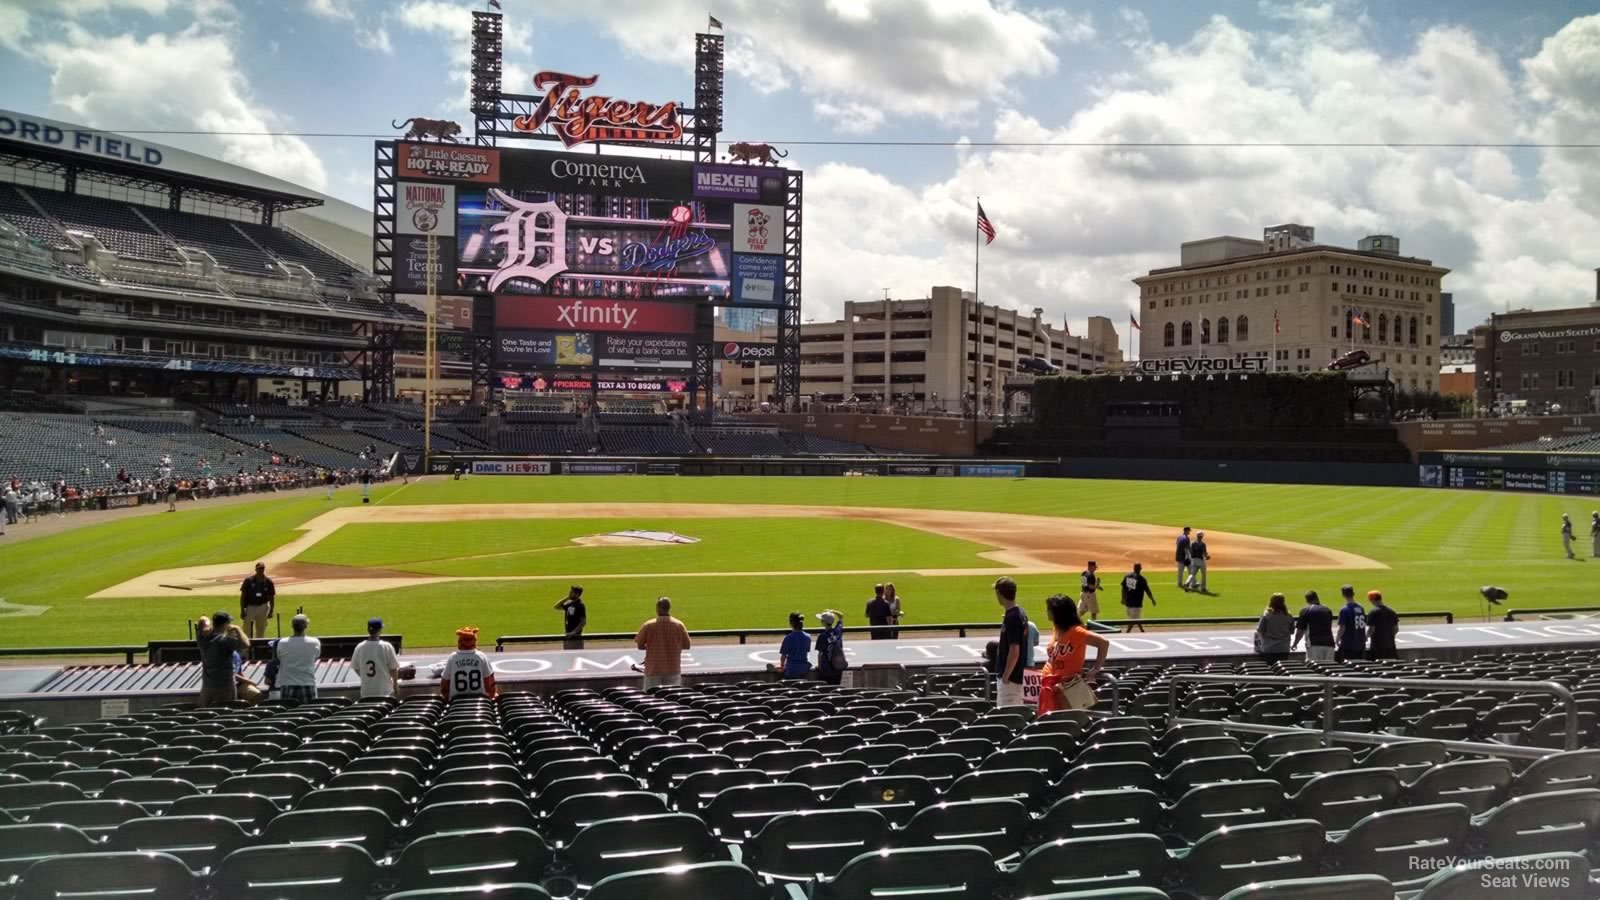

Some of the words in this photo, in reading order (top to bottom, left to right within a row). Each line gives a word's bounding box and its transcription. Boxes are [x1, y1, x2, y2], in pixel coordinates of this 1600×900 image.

[513, 71, 682, 150] Tigers
[74, 130, 163, 166] FIELD
[424, 148, 449, 160] Little
[450, 150, 487, 163] Caesars
[407, 158, 490, 174] HOT-N-READY
[427, 170, 470, 178] PIZZA
[697, 172, 758, 187] NEXEN
[577, 177, 622, 187] PARK
[406, 186, 445, 202] NATIONAL
[747, 237, 768, 245] BELLE
[622, 228, 716, 271] Dodgers
[739, 256, 777, 265] Confidence
[556, 300, 638, 329] xfinity
[440, 335, 463, 344] Green
[502, 338, 518, 346] One
[519, 339, 536, 347] Taste
[606, 337, 627, 346] Raise
[627, 339, 643, 347] your
[644, 339, 687, 348] expectations
[608, 345, 616, 354] of
[617, 346, 634, 354] what
[642, 347, 660, 355] bank
[676, 348, 688, 356] be.
[742, 346, 775, 358] pepsi
[1142, 357, 1271, 373] CHEVROLET
[553, 380, 592, 389] #PICKRICK
[638, 382, 661, 390] 89269
[475, 464, 502, 473] DMC
[992, 468, 1016, 476] Energy
[366, 660, 376, 677] 3
[455, 659, 480, 668] TIGGER
[454, 669, 482, 692] 68
